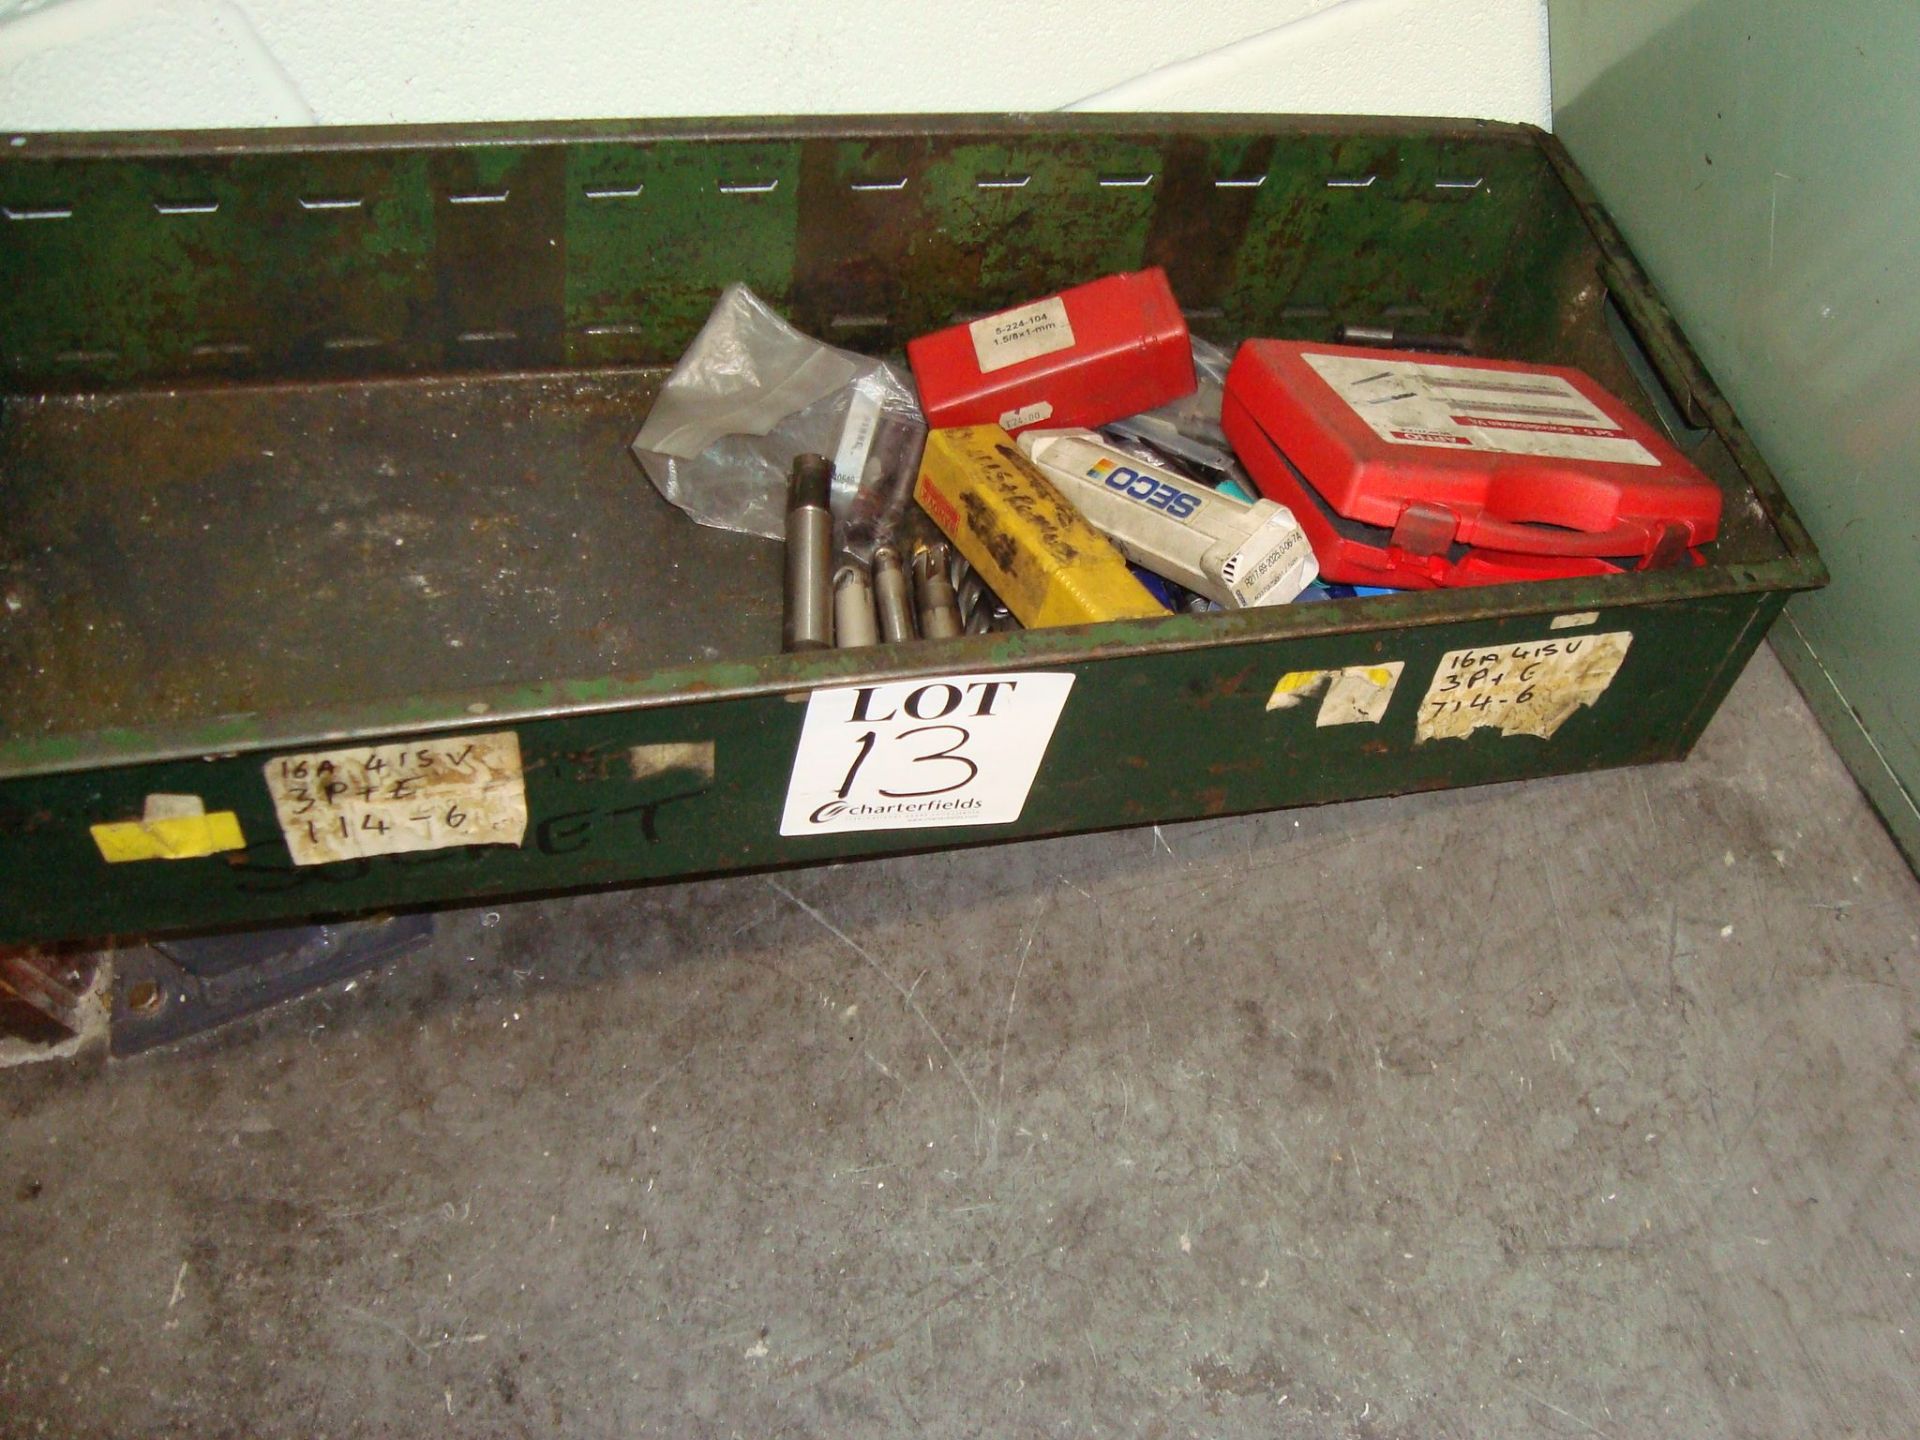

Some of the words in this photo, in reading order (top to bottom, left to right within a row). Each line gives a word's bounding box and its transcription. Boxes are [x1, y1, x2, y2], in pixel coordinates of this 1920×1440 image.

[1105, 466, 1202, 518] SECO
[845, 681, 1018, 723] LOT
[281, 759, 336, 779] 16A
[834, 725, 978, 799] 13
[848, 798, 983, 816] charterfields
